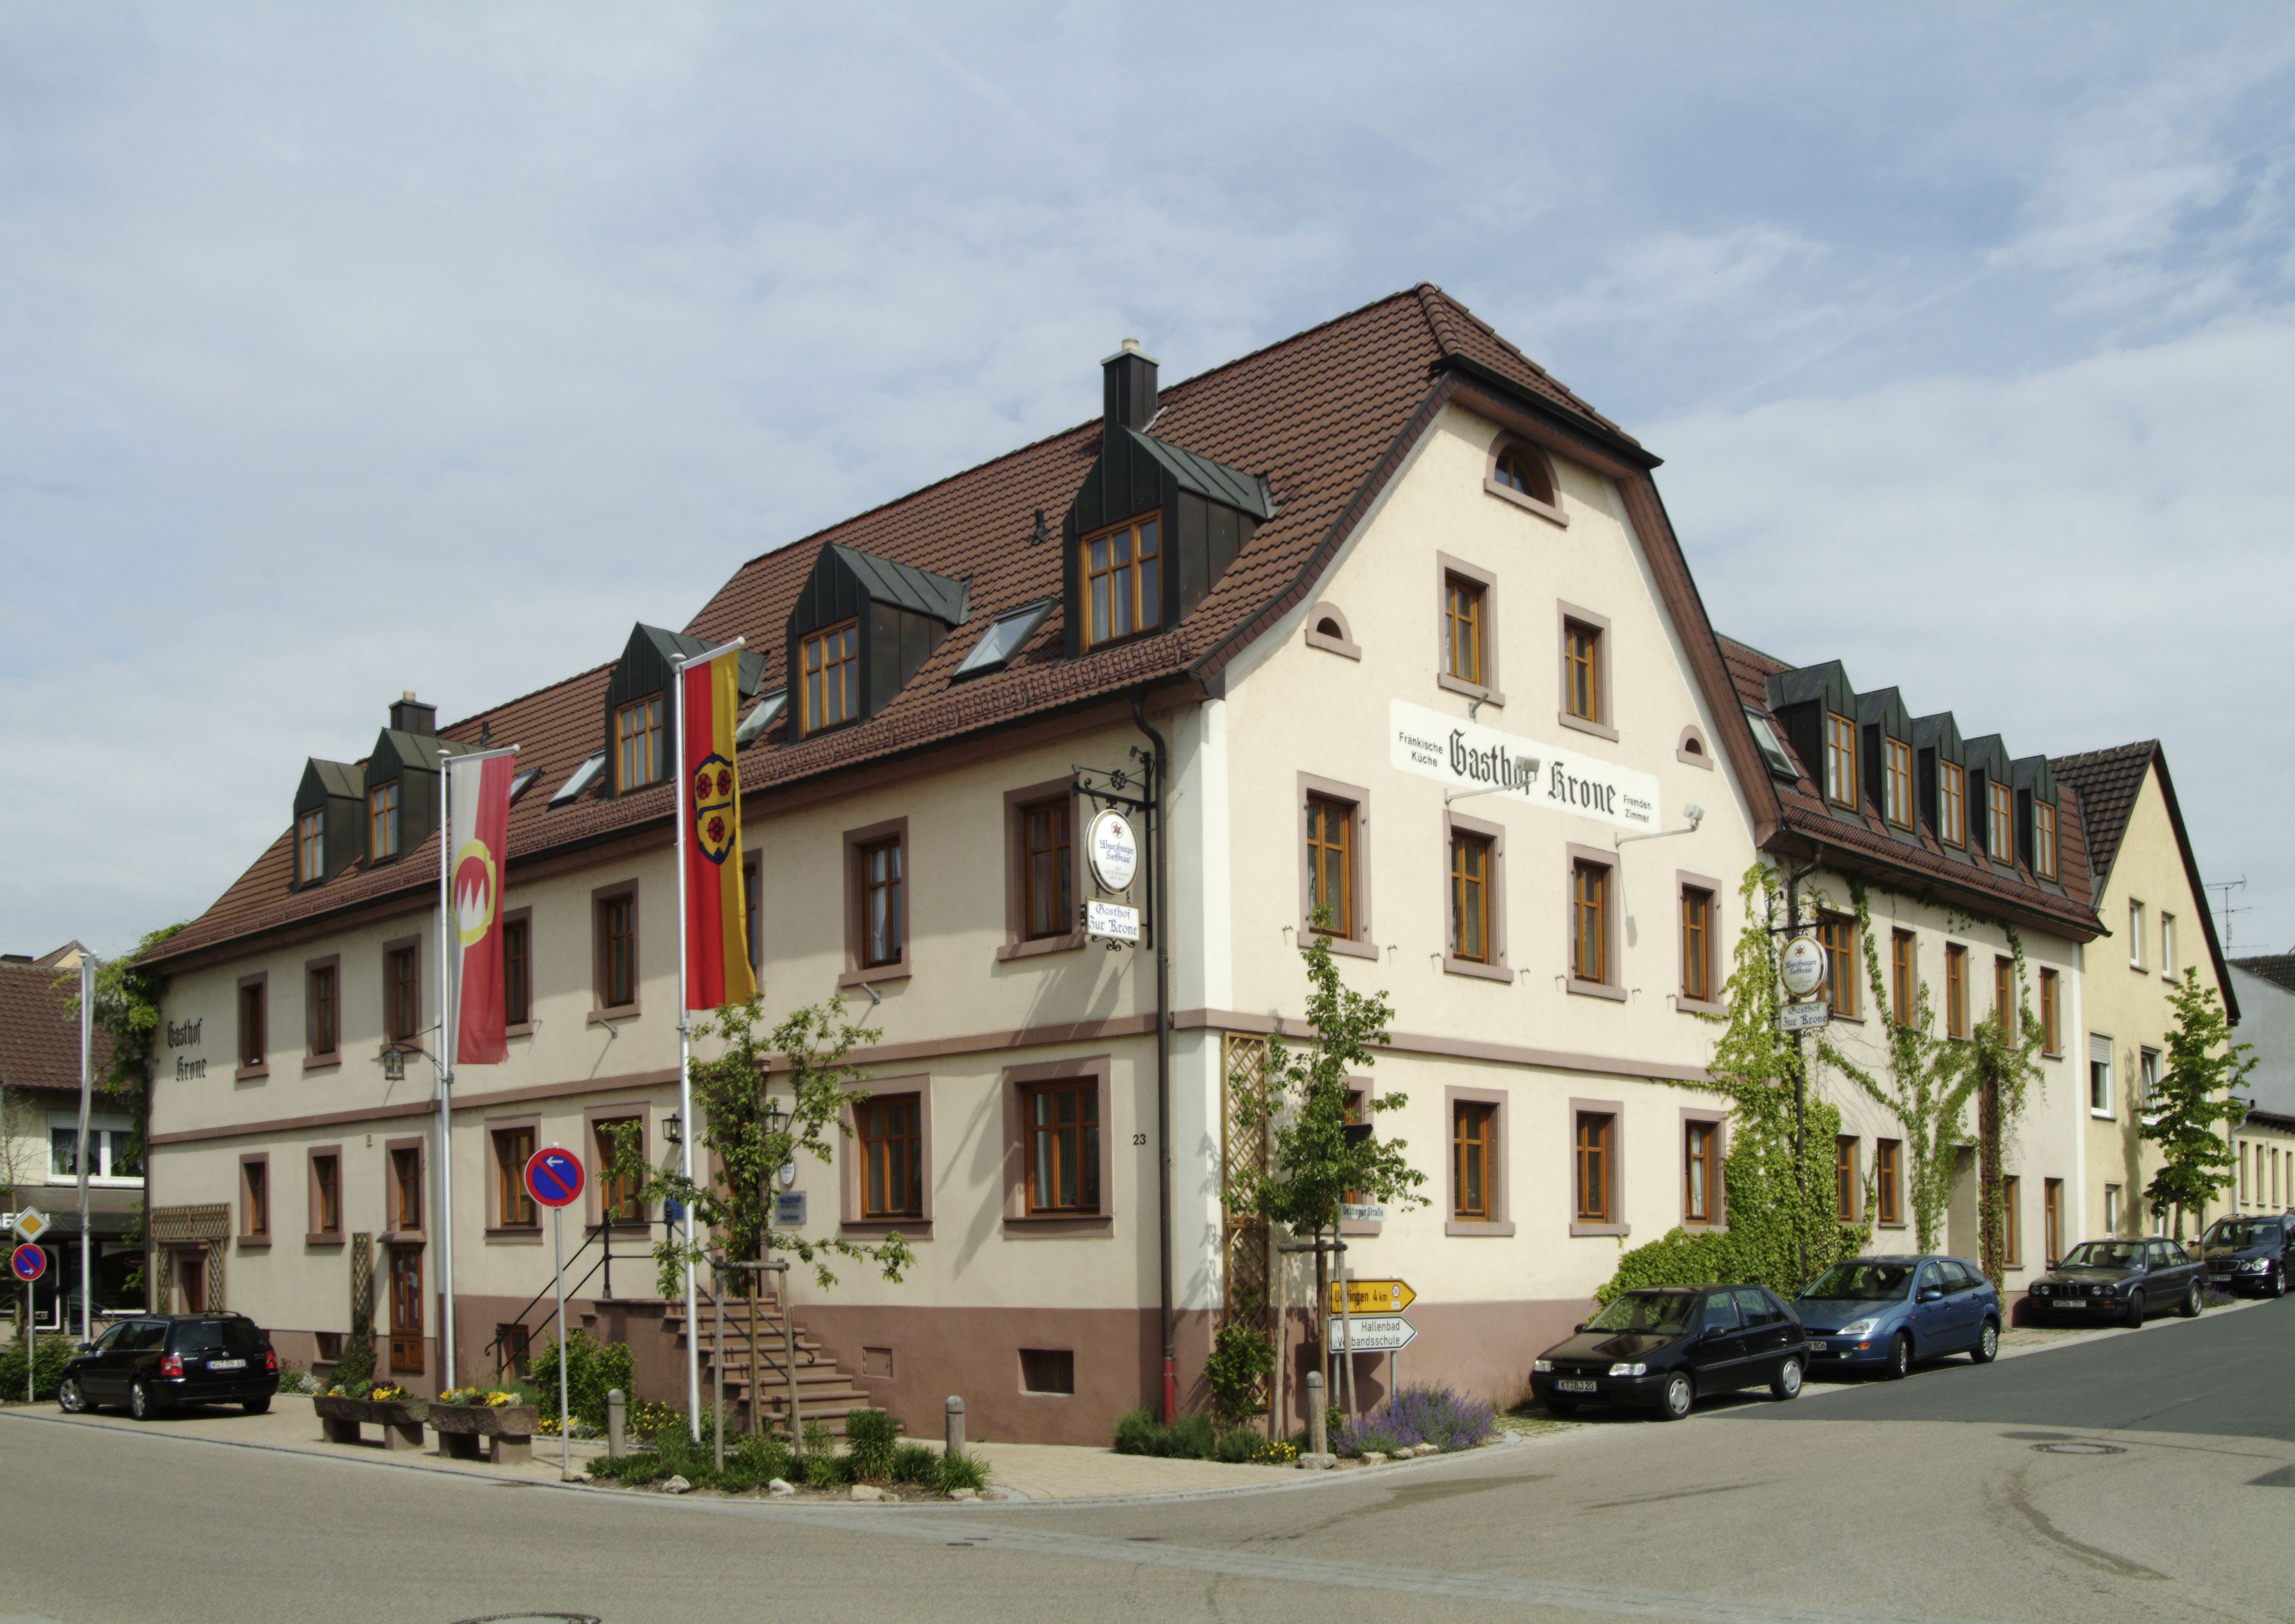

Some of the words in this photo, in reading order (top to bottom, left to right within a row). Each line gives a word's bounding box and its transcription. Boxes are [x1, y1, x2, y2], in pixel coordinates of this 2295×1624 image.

[1399, 732, 1443, 754] Fränkische
[1411, 750, 1438, 767] Küche
[1548, 761, 1615, 815] Krone
[1623, 794, 1652, 811] Fremden
[1625, 809, 1650, 824] Zimmer
[1096, 903, 1131, 920] Gasthof
[1108, 919, 1137, 935] Krone
[1788, 1004, 1821, 1014] Gasthof
[1800, 1014, 1826, 1024] Krone
[167, 1017, 203, 1048] Gasthof
[176, 1056, 207, 1082] Krone
[1133, 1134, 1146, 1145] 23
[1373, 1289, 1378, 1302] 4
[1379, 1292, 1388, 1301] km
[1361, 1320, 1400, 1332] Hallenbad
[1338, 1335, 1400, 1347] Vebandsschule
